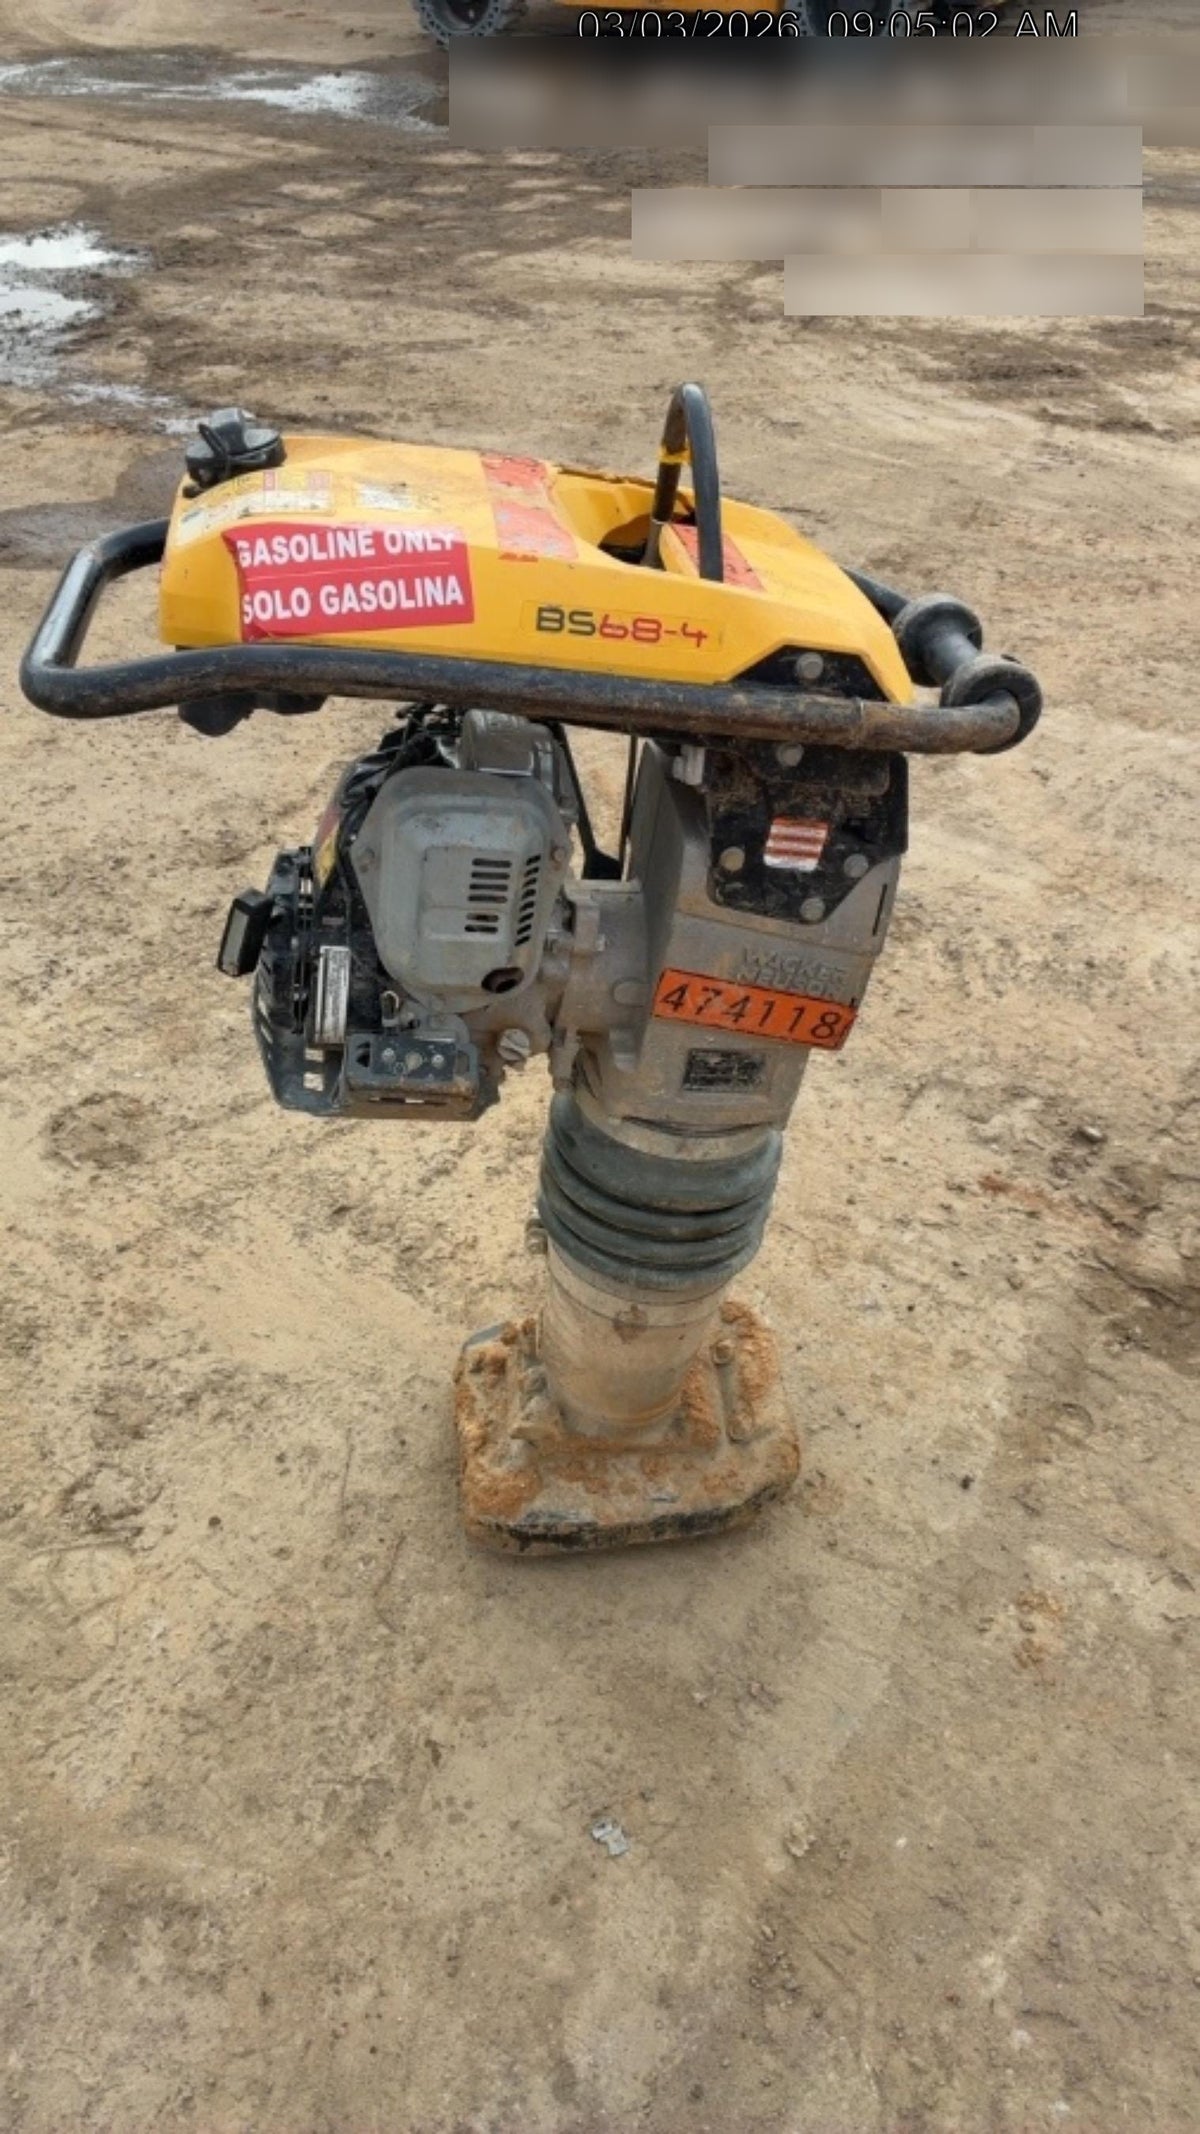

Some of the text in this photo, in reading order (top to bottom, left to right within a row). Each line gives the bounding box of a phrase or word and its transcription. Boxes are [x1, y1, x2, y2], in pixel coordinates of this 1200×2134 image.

[236, 529, 456, 568] GASOLINE ONLY
[243, 574, 464, 624] SOLO GASOLINA
[536, 606, 708, 648] BS68-4
[659, 983, 842, 1040] 474118
